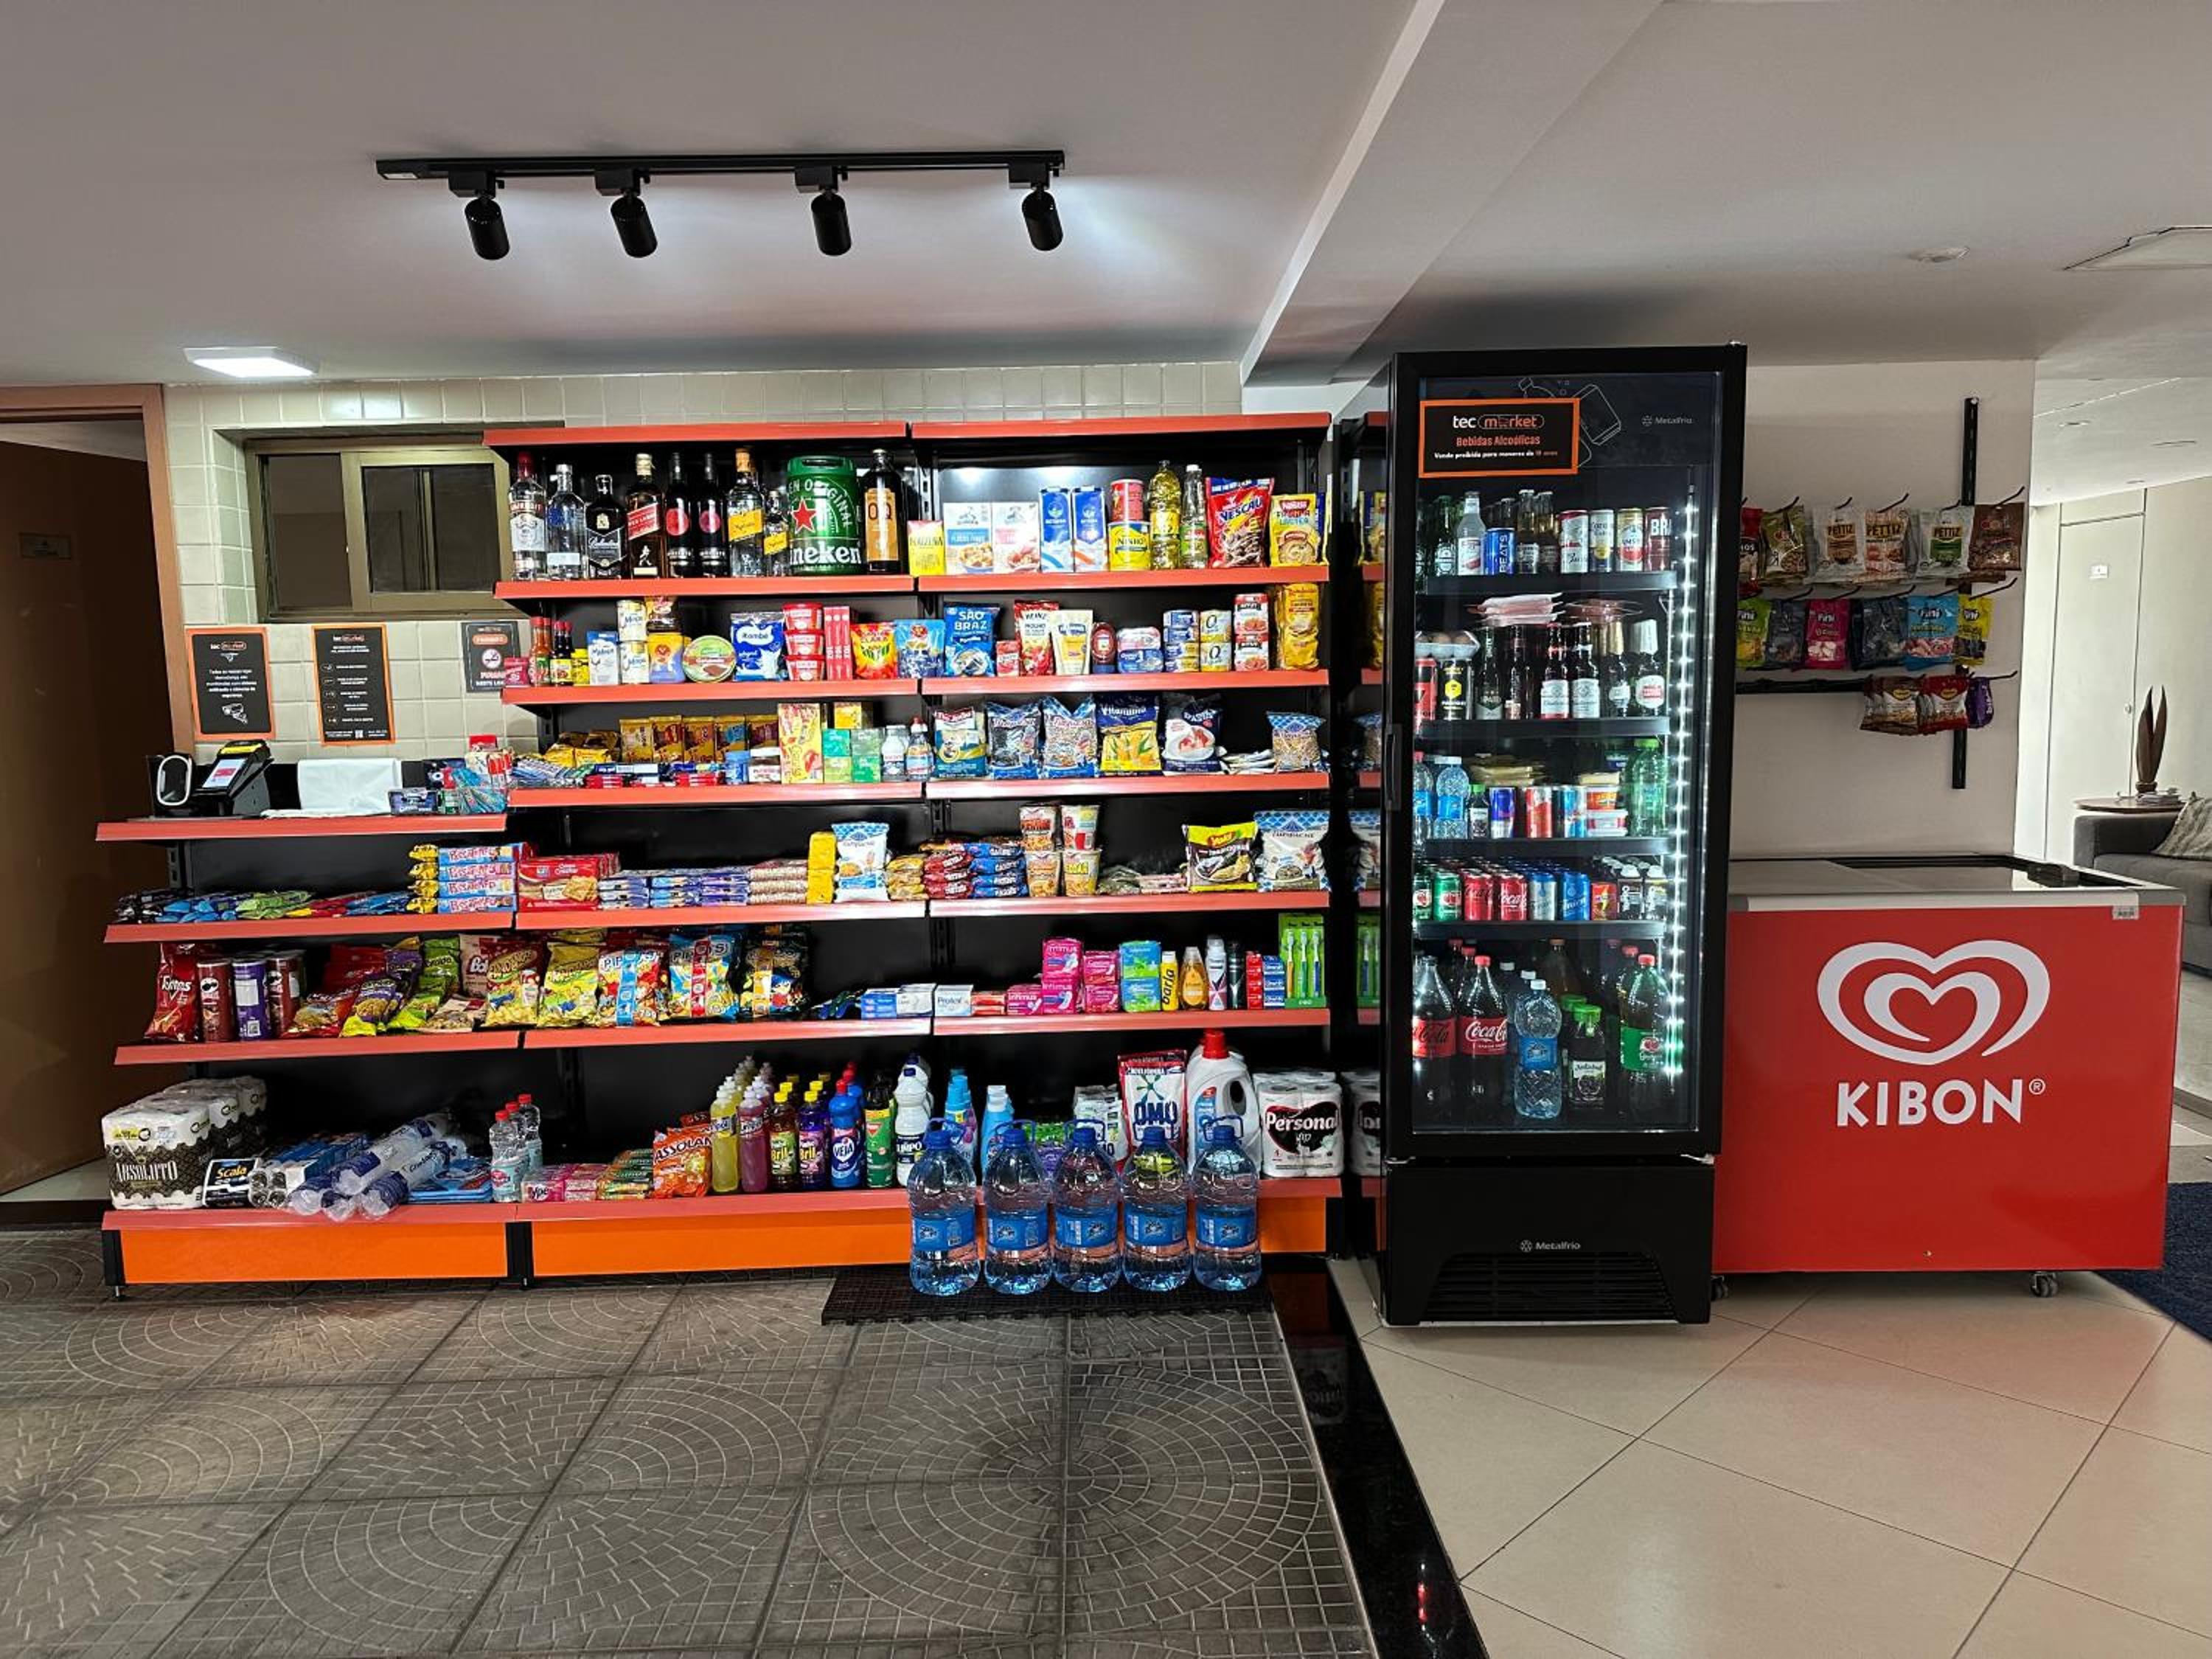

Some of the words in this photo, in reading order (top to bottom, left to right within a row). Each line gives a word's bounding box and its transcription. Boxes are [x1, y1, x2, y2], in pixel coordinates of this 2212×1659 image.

[1453, 415, 1476, 428] tec
[1456, 437, 1493, 447] Bebidas
[1494, 435, 1541, 445] Alcoólicas
[1455, 451, 1481, 459] proibida
[1220, 498, 1262, 521] NESCAU
[1828, 524, 1854, 535] PETTIZ
[1865, 522, 1902, 536] PETTIZ
[1933, 527, 1961, 538] PETTIZ
[790, 540, 861, 565] ineken
[959, 610, 985, 620] SÃO
[954, 622, 987, 630] BRAZ
[1836, 1078, 2023, 1128] KIBON
[1134, 1102, 1178, 1124] OMO
[1266, 1108, 1340, 1132] Personal
[116, 1160, 178, 1181] ABSOLUTO
[216, 1165, 248, 1179] Scala
